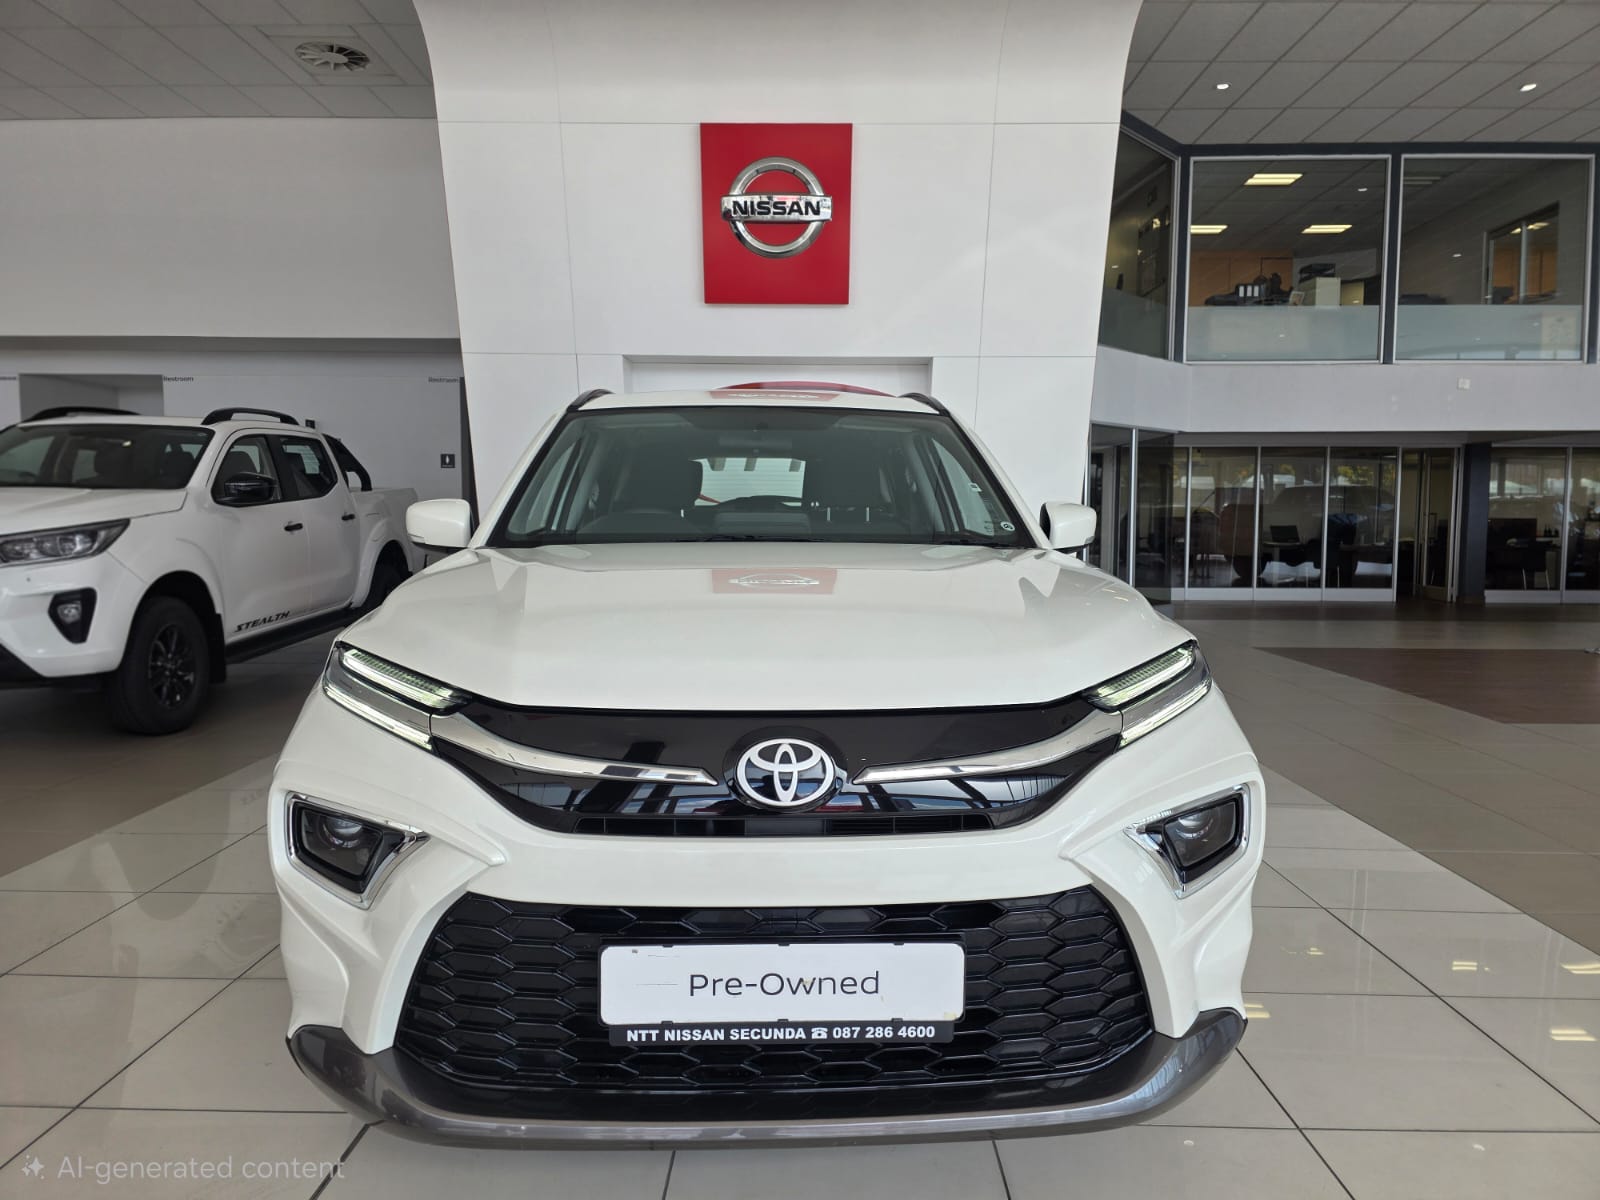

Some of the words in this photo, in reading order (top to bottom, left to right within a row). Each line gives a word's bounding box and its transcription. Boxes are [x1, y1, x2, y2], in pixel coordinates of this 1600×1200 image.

[732, 200, 821, 216] NISSAN
[234, 610, 290, 633] STEALTH
[689, 970, 879, 997] Pre-Owned
[626, 1029, 659, 1042] NTT
[664, 1028, 725, 1042] NISSAN
[729, 1027, 806, 1040] SECUNDA
[832, 1026, 861, 1039] 087
[865, 1026, 893, 1039] 286
[897, 1025, 936, 1038] 4600
